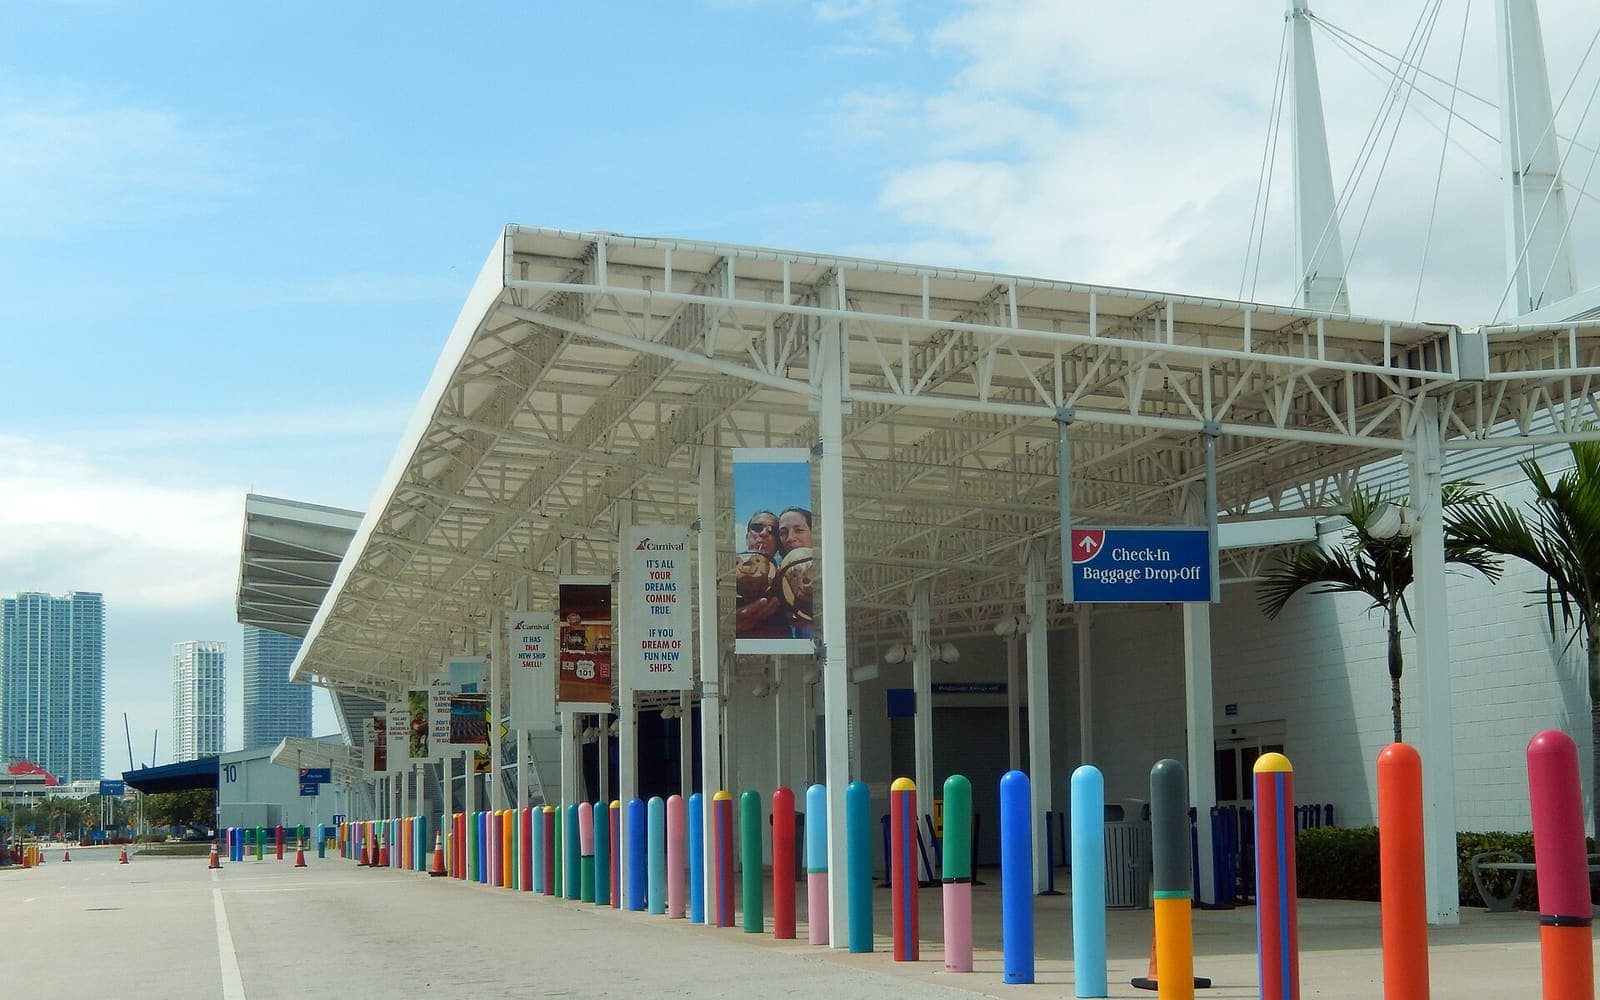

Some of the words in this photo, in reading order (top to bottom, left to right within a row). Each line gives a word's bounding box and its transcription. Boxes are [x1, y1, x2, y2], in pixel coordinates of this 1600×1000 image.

[647, 542, 684, 551] Carnival
[1112, 548, 1170, 562] Check-In
[646, 560, 660, 569] IT'S
[661, 560, 674, 569] ALL
[650, 571, 671, 580] YOUR
[1083, 567, 1141, 584] Baggage
[1145, 567, 1201, 583] Drop-Off
[645, 583, 676, 592] DREAMS
[645, 594, 677, 603] COMING
[650, 606, 671, 615] TRUE.
[649, 629, 657, 638] IF
[657, 629, 674, 638] YOU
[642, 641, 670, 649] DREAM
[671, 641, 682, 649] OF
[644, 652, 659, 661] FUN
[661, 652, 680, 661] NEW
[579, 669, 592, 677] 101
[649, 664, 674, 673] SHIPS.
[224, 765, 237, 783] 10
